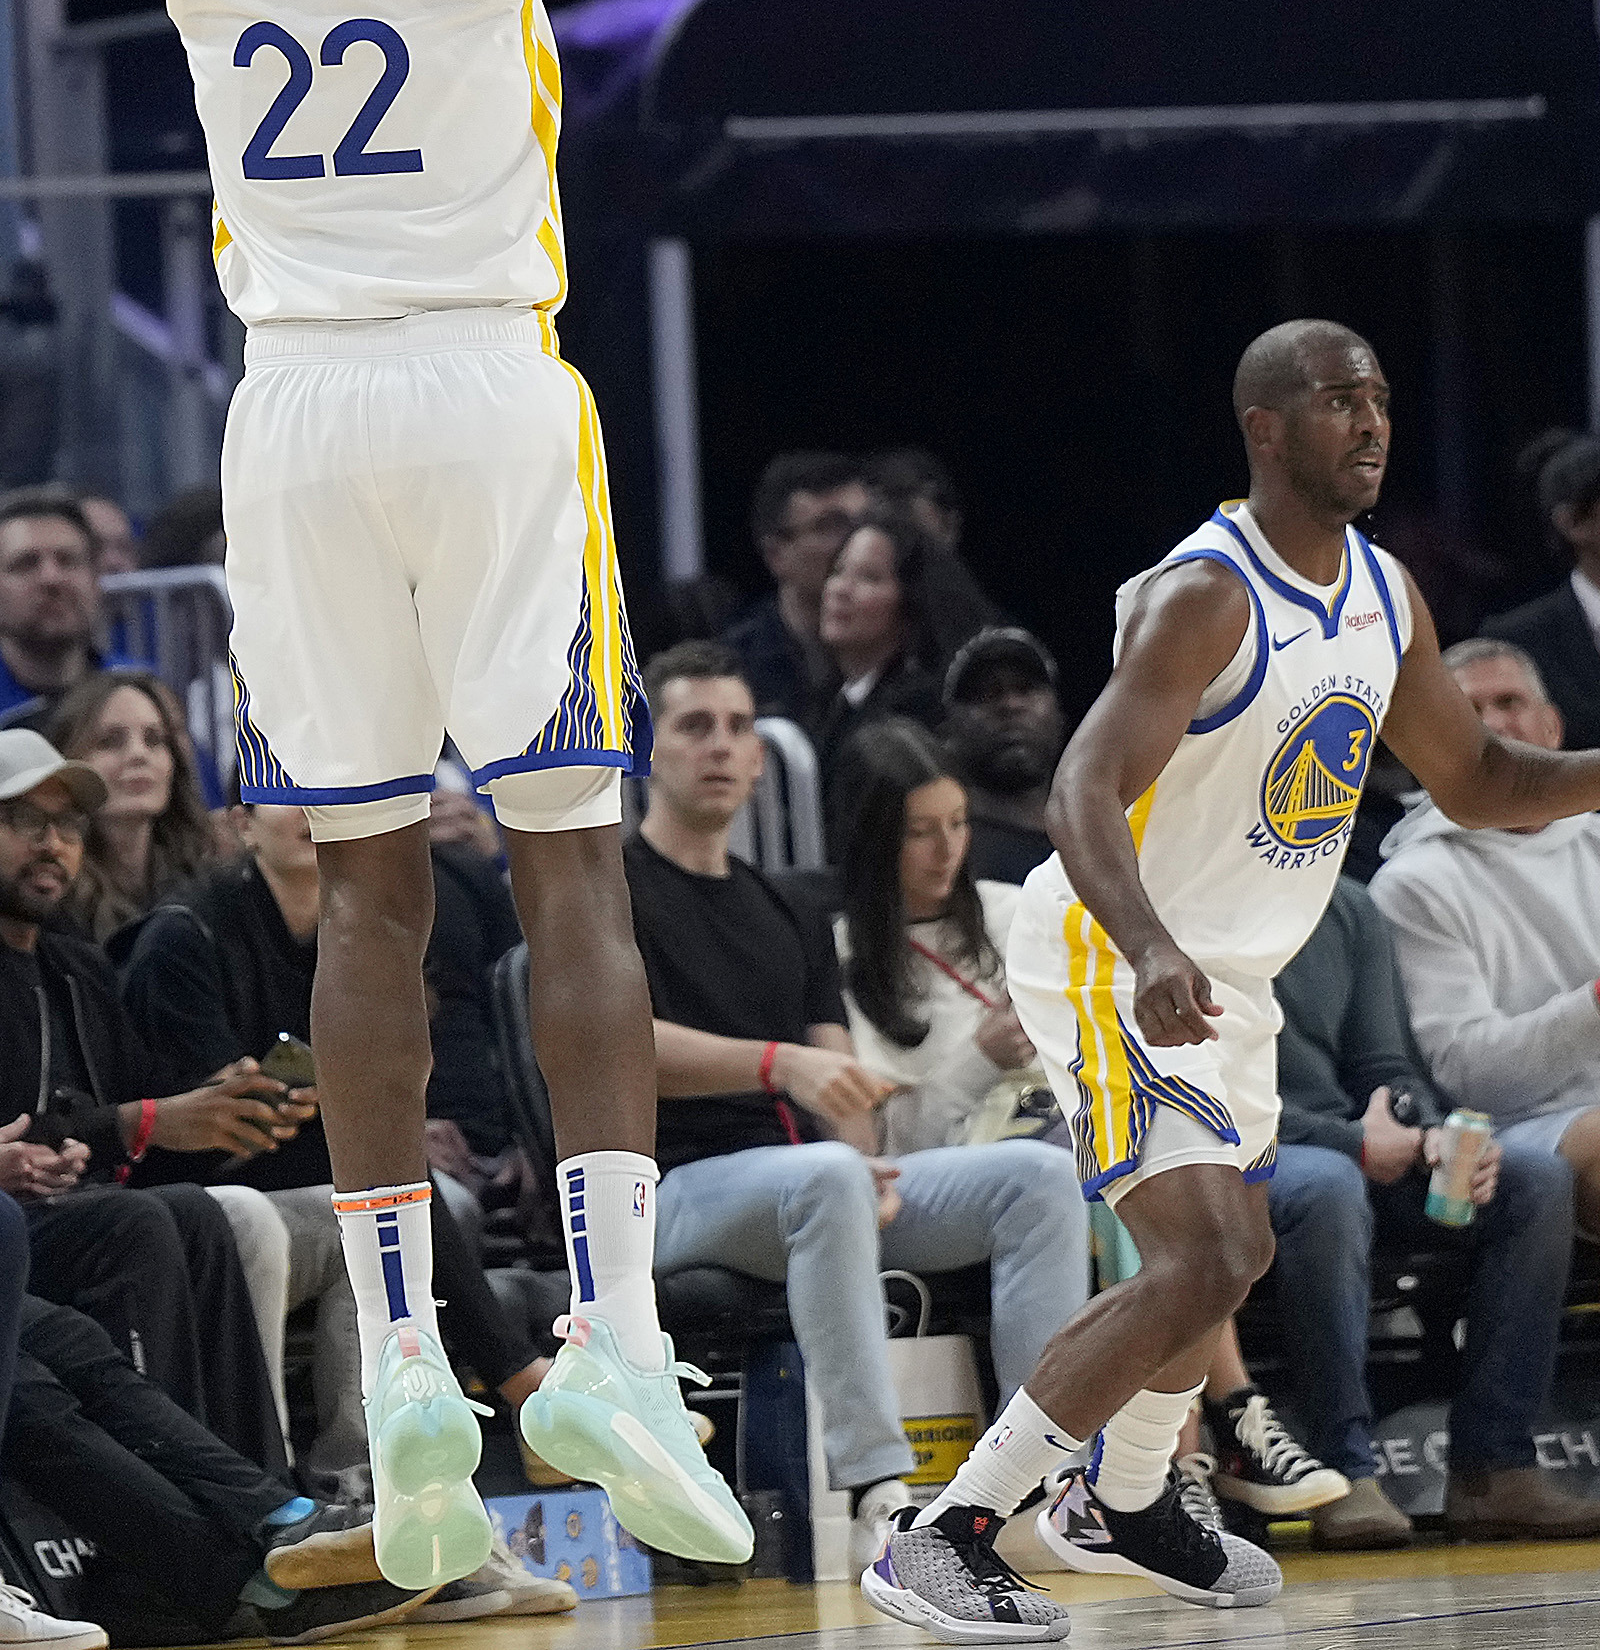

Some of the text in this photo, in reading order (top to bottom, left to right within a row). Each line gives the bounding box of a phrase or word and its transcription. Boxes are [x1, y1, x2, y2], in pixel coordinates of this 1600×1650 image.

[232, 17, 425, 181] 22
[1344, 610, 1384, 632] Rakuten
[1276, 674, 1384, 734] GOLDEN STATE
[1342, 728, 1367, 772] 3
[1245, 822, 1352, 870] WARRIOR
